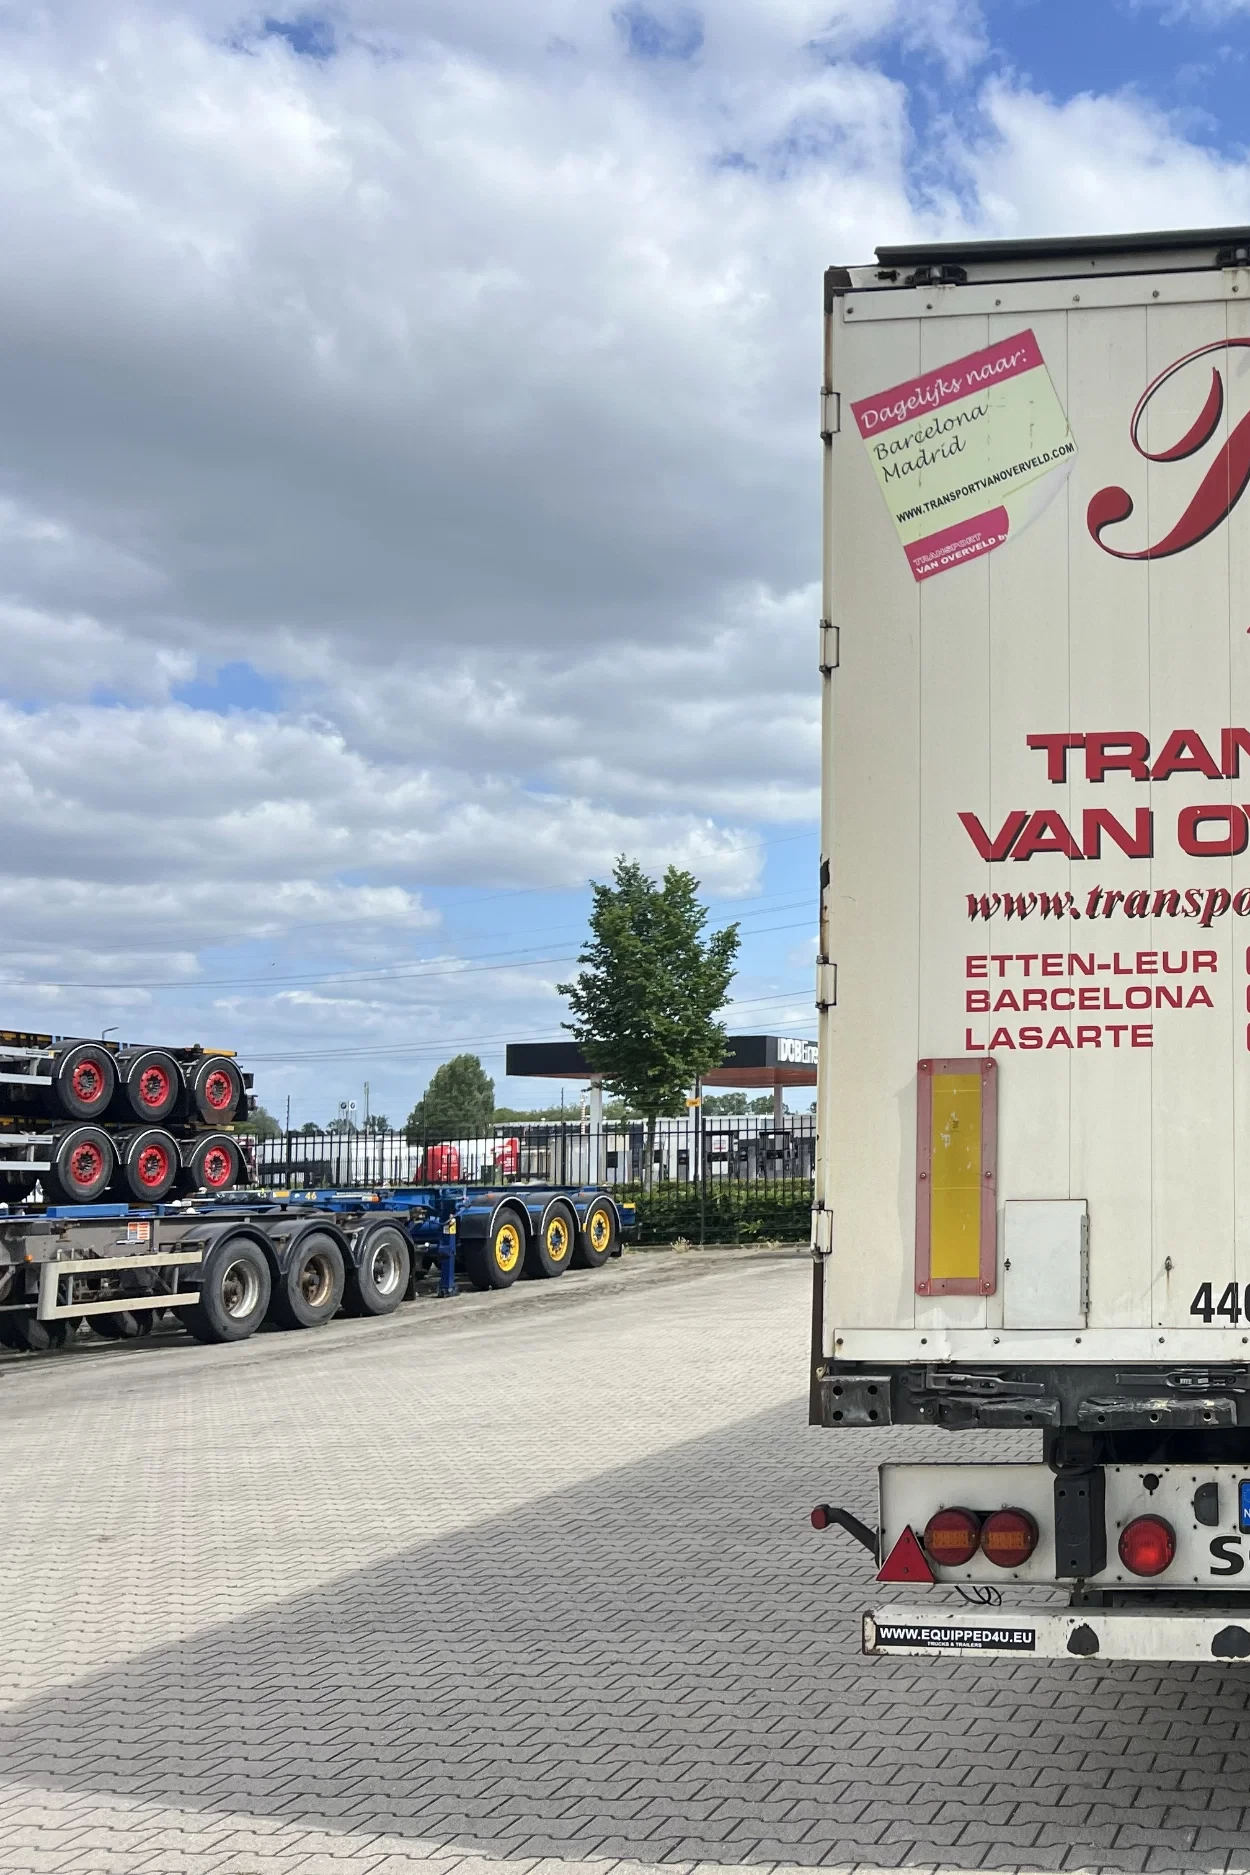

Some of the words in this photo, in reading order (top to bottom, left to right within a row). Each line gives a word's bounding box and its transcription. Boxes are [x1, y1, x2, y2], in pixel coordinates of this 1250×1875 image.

[861, 379, 962, 428] Dagelijks
[966, 348, 1027, 385] naar:
[873, 404, 989, 461] Barcelona
[882, 435, 967, 482] Madrid
[896, 442, 1075, 523] WWW.TRANSPORTVANOVERVELD.COM
[913, 533, 981, 566] TRANSPORT
[916, 561, 939, 574] VAN
[941, 537, 996, 565] OVERVELD
[957, 807, 1154, 862] VAN
[965, 950, 1218, 978] ETTEN-LEUR
[965, 985, 1214, 1013] BARCELONA
[965, 1024, 1154, 1051] LASARTE
[879, 1627, 1032, 1643] WWW.EQUIPPED4U.EU
